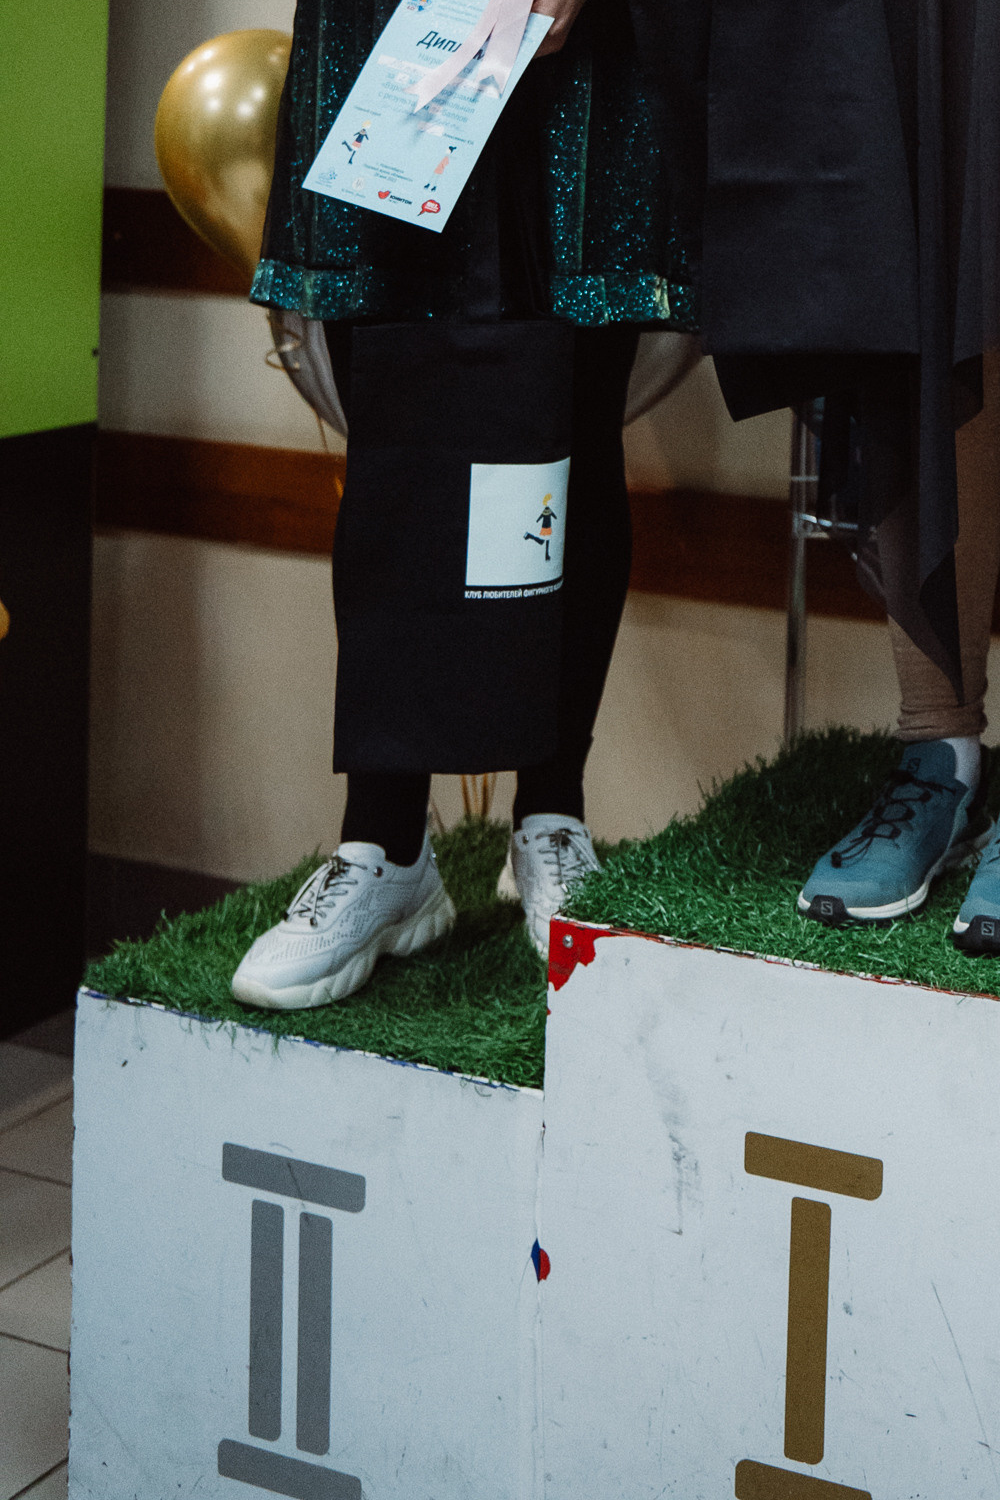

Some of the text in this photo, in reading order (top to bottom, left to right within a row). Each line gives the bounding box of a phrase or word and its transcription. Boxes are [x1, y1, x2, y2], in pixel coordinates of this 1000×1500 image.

[416, 30, 484, 61] Диплм
[464, 590, 482, 599] КЛУБ
[483, 588, 523, 599] ЛЮБИТЕЛЕЙ
